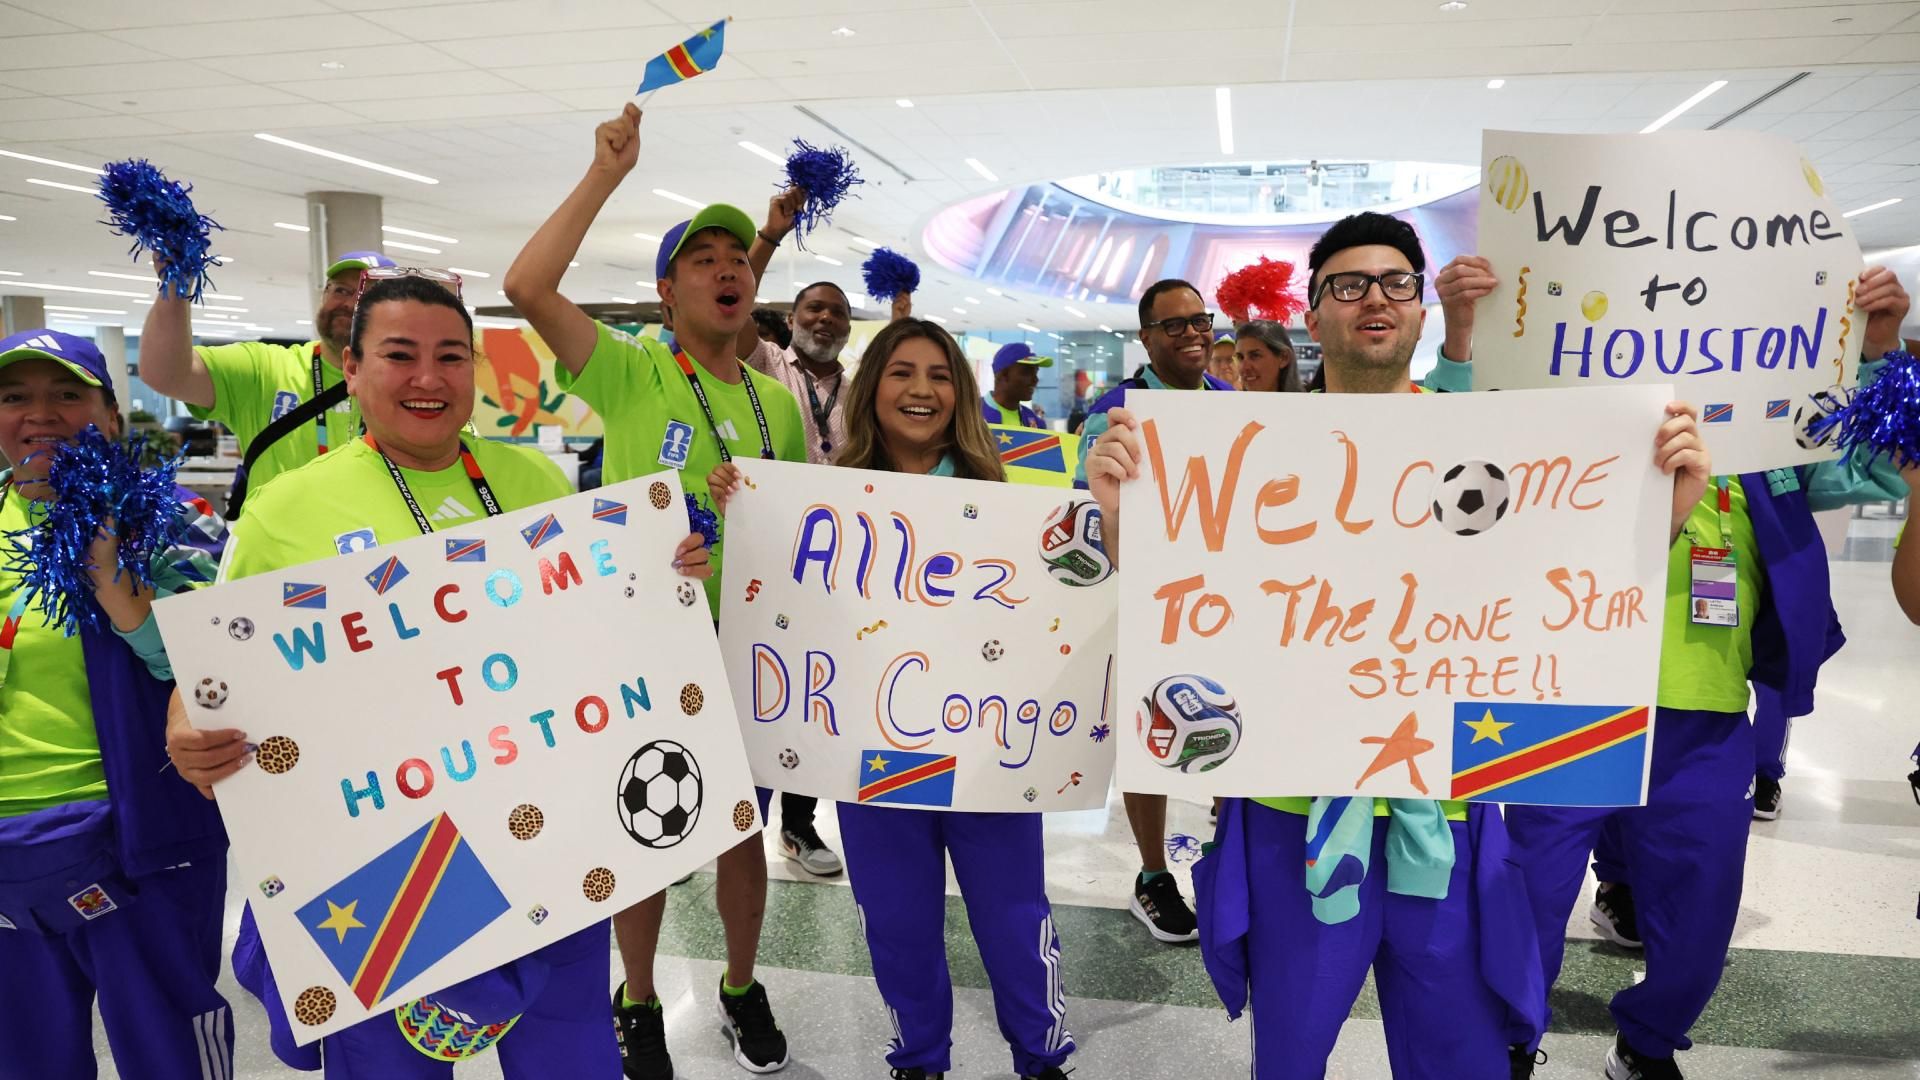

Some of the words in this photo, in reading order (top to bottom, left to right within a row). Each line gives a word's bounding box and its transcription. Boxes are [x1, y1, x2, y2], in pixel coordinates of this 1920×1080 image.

[1533, 185, 1843, 252] Welcome
[1640, 274, 1708, 312] to
[1549, 307, 1827, 379] HOUSTON
[748, 387, 761, 411] WORLD
[756, 411, 766, 426] CUP
[392, 469, 412, 499] WORLD
[408, 499, 422, 517] CUP
[479, 486, 498, 514] 2026
[790, 503, 1030, 610] Allez
[273, 538, 617, 671] WELCOME
[436, 652, 519, 705] TO
[752, 643, 841, 737] DR
[875, 652, 1112, 770] Congo!
[340, 676, 653, 818] HOUSTON
